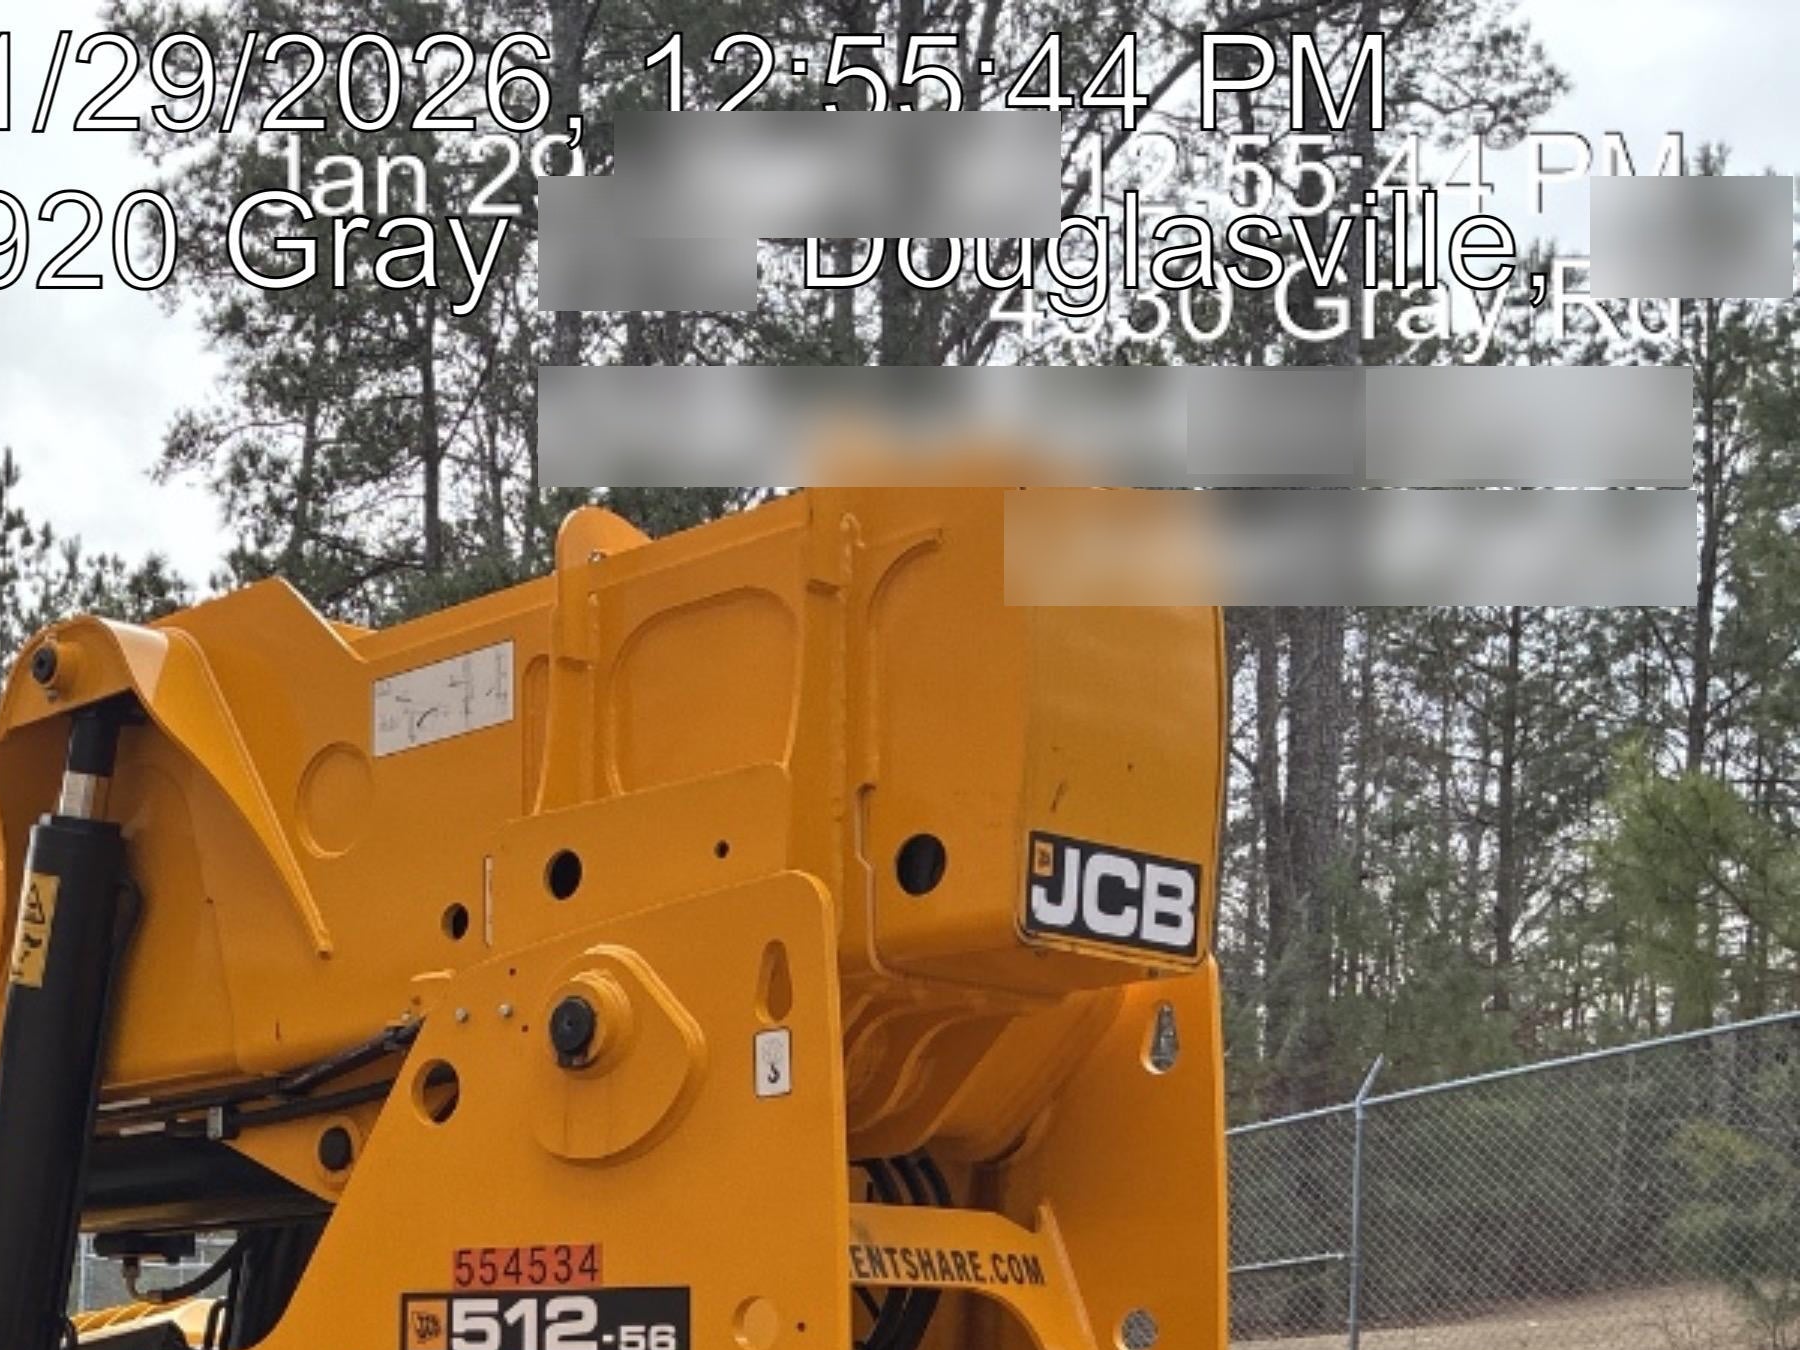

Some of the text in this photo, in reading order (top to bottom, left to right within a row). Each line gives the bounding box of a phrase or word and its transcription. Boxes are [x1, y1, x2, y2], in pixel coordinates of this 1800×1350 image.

[1031, 846, 1196, 947] JCB
[455, 1245, 600, 1287] 554534
[849, 1244, 1046, 1286] ENTSHARE.COM
